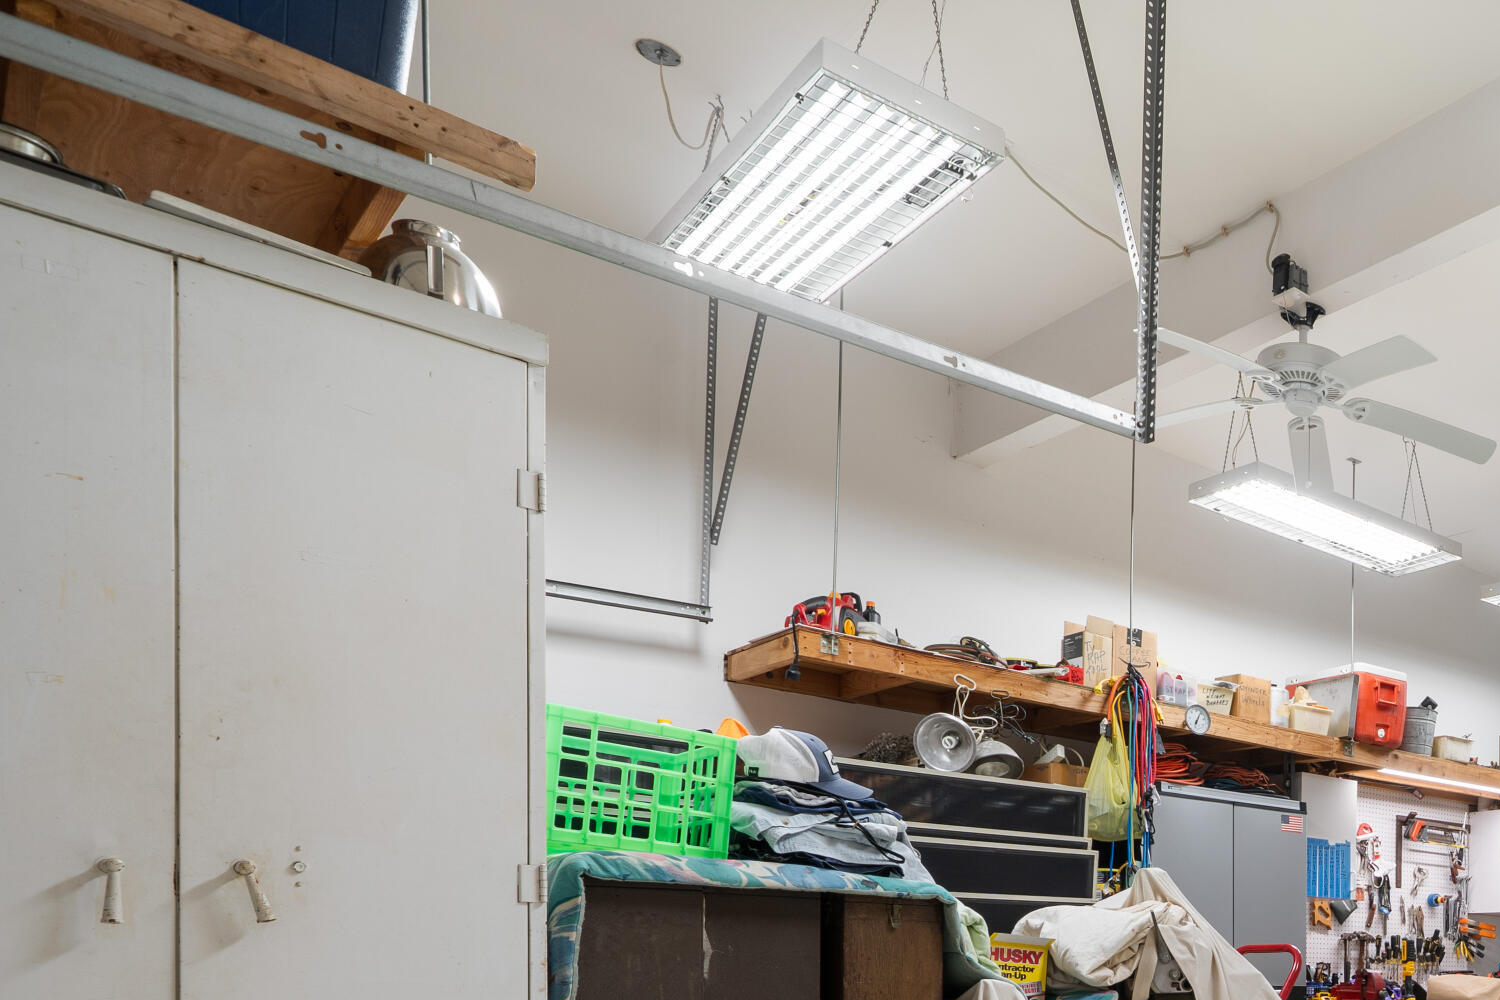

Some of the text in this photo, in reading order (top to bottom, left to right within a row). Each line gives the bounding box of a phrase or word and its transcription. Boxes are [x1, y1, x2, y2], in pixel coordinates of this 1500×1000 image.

[990, 947, 1044, 965] HUSKY
[999, 963, 1035, 973] ntractor
[1001, 972, 1027, 981] an-Up
